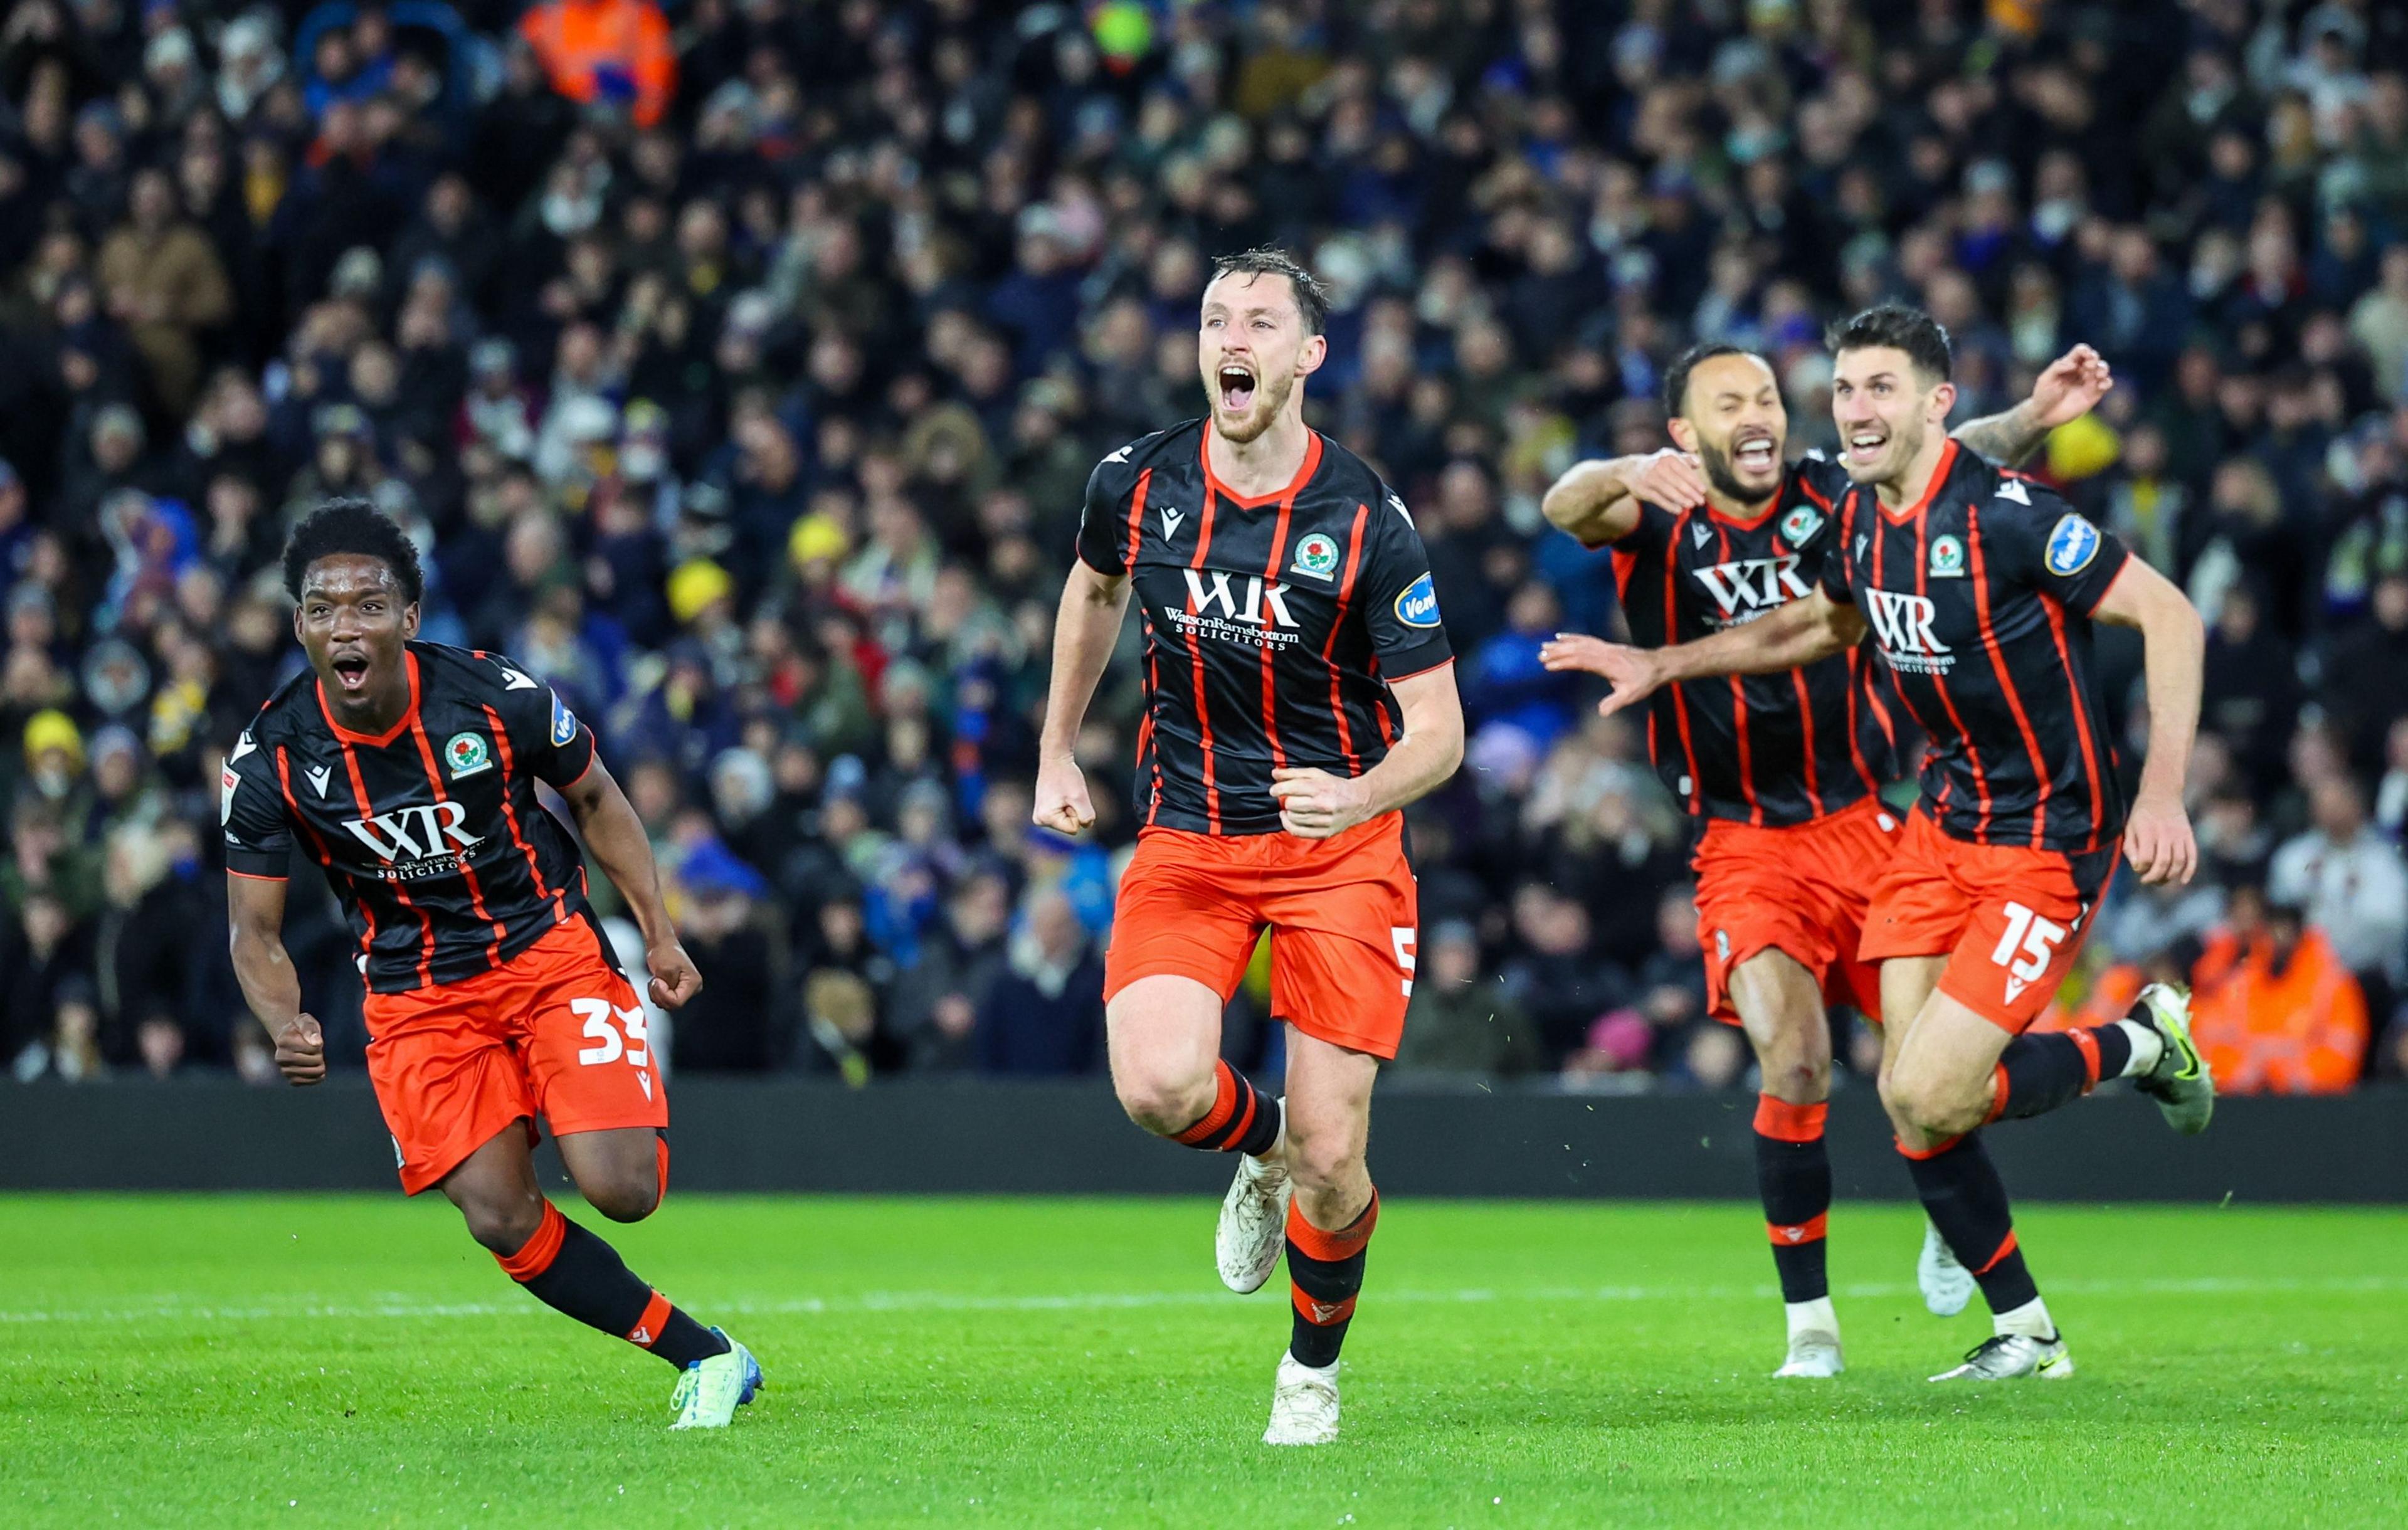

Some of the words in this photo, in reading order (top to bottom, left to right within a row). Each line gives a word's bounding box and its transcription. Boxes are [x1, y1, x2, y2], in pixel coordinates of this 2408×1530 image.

[1164, 606, 1299, 643] WatsonRamsbottom
[1176, 623, 1286, 652] SOLICITORS
[1865, 586, 1952, 652] WR
[341, 801, 485, 862] WR
[1390, 927, 1416, 998] 5
[1990, 900, 2066, 982] 15
